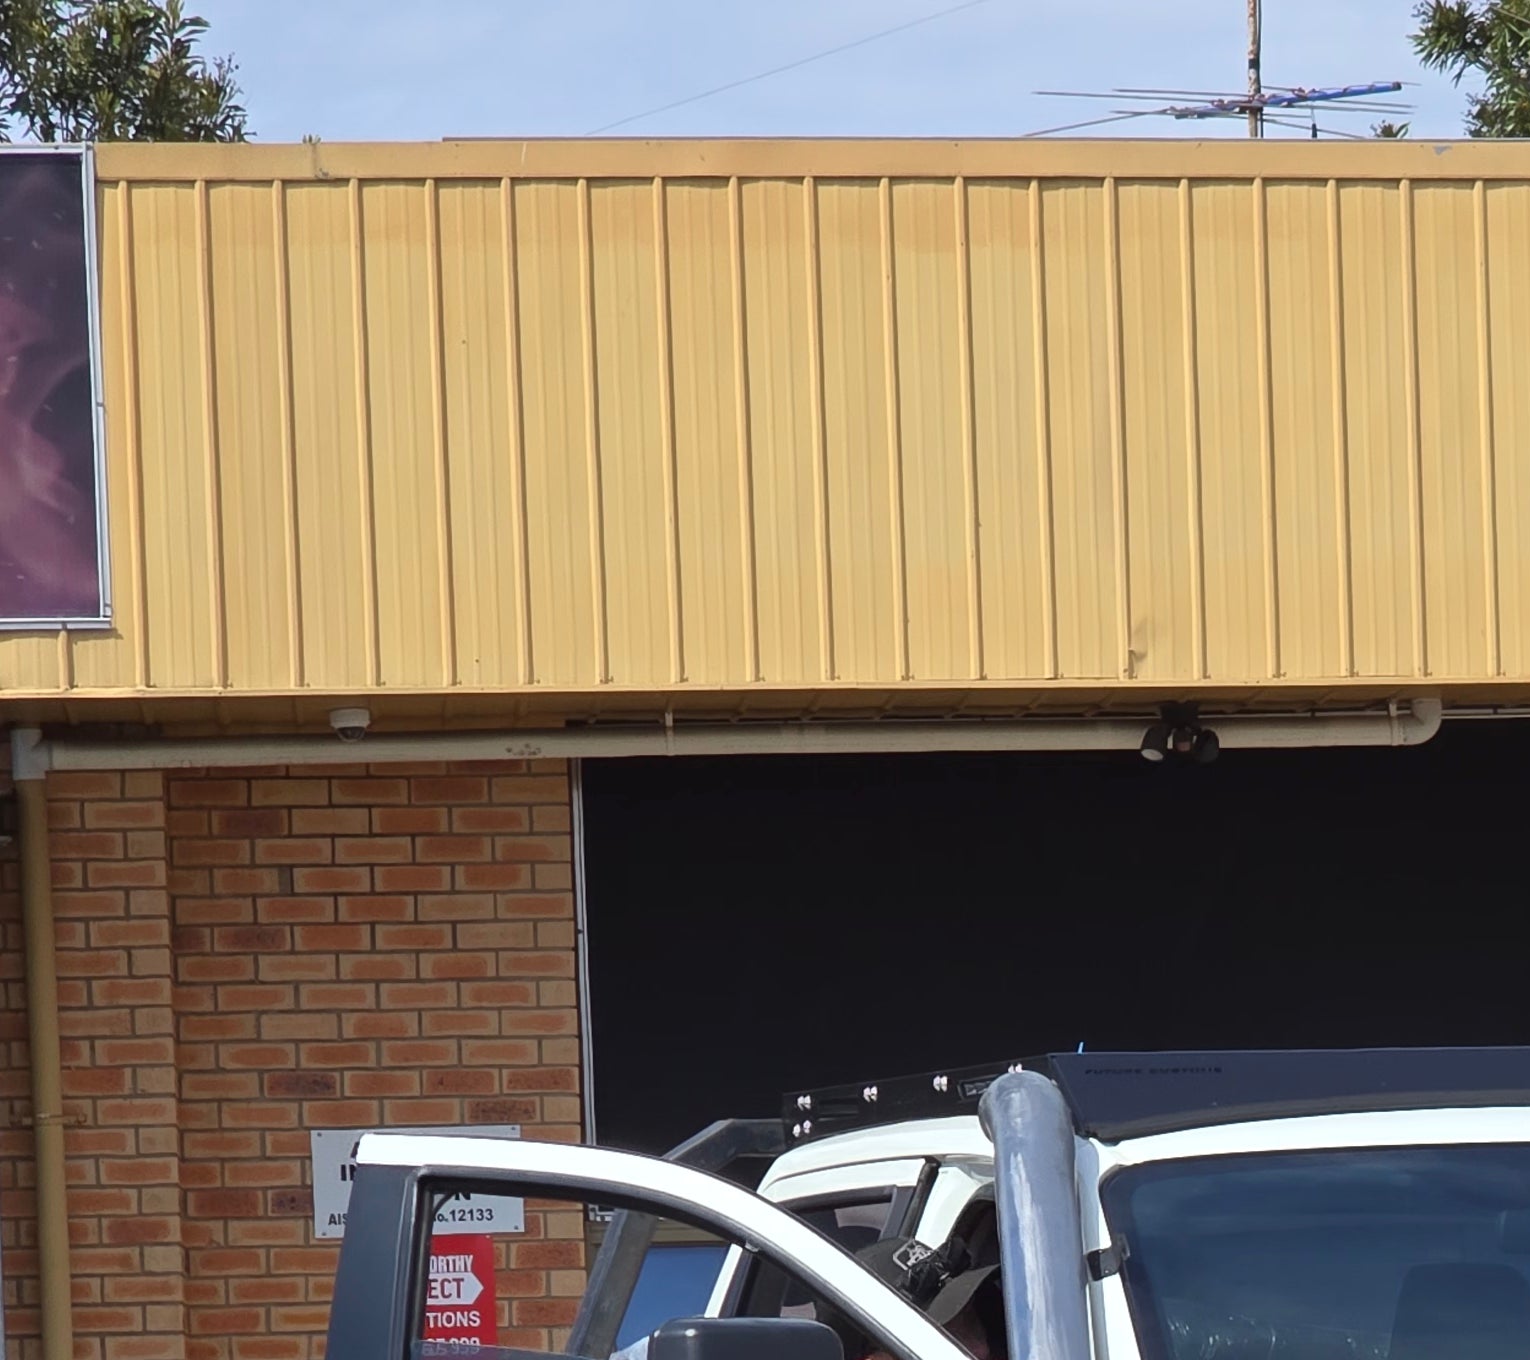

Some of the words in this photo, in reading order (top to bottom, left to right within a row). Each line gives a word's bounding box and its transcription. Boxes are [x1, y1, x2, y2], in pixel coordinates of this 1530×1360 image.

[430, 1255, 473, 1273] ORTHY
[428, 1278, 464, 1299] ECT
[426, 1311, 481, 1328] TIONS
